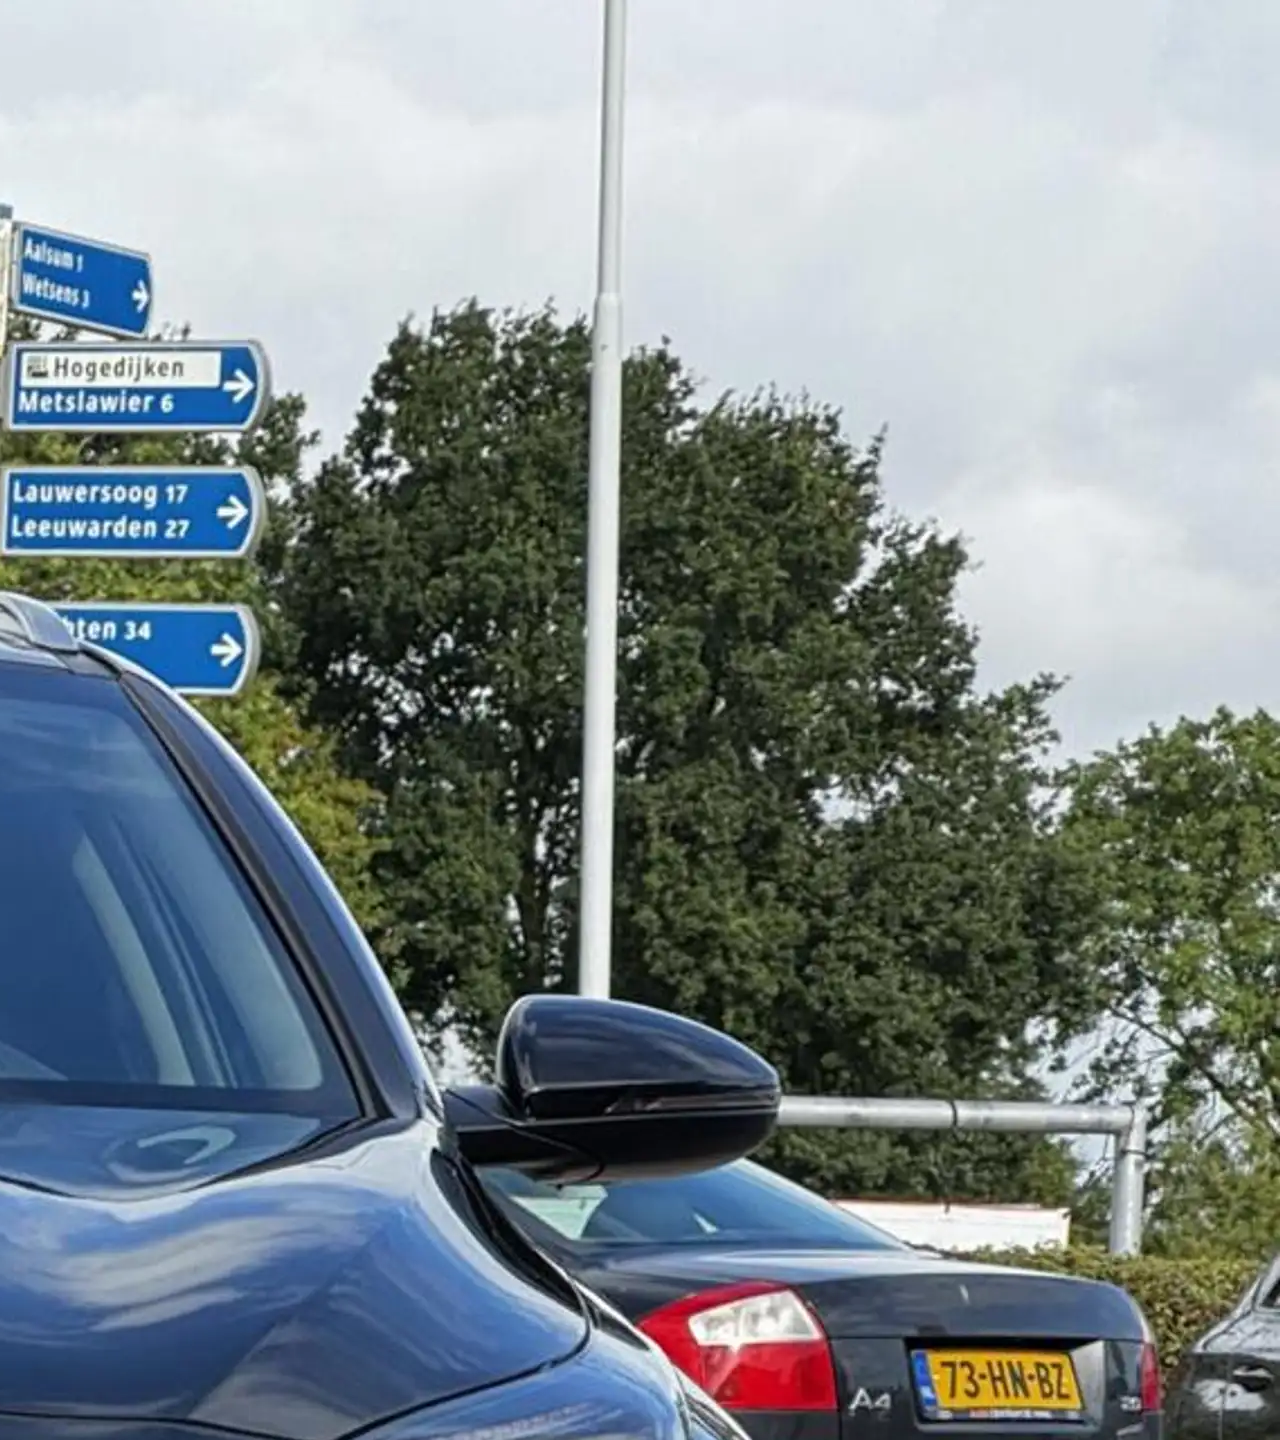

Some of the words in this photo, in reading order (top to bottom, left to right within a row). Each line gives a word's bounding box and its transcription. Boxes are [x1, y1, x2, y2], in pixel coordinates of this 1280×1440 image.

[23, 236, 74, 270] Aalsum
[22, 271, 80, 307] Wetsens
[53, 357, 184, 381] Hogedijken
[18, 390, 154, 413] Metslawier
[160, 393, 174, 413] 6
[13, 479, 157, 510] Lauwersoog
[165, 484, 189, 503] 17
[11, 515, 157, 538] Leeuwarden
[164, 519, 190, 538] 27
[61, 614, 117, 641] hten
[124, 620, 151, 641] 34
[940, 1360, 1071, 1399] 73-HN-BZ
[848, 1386, 891, 1411] A4
